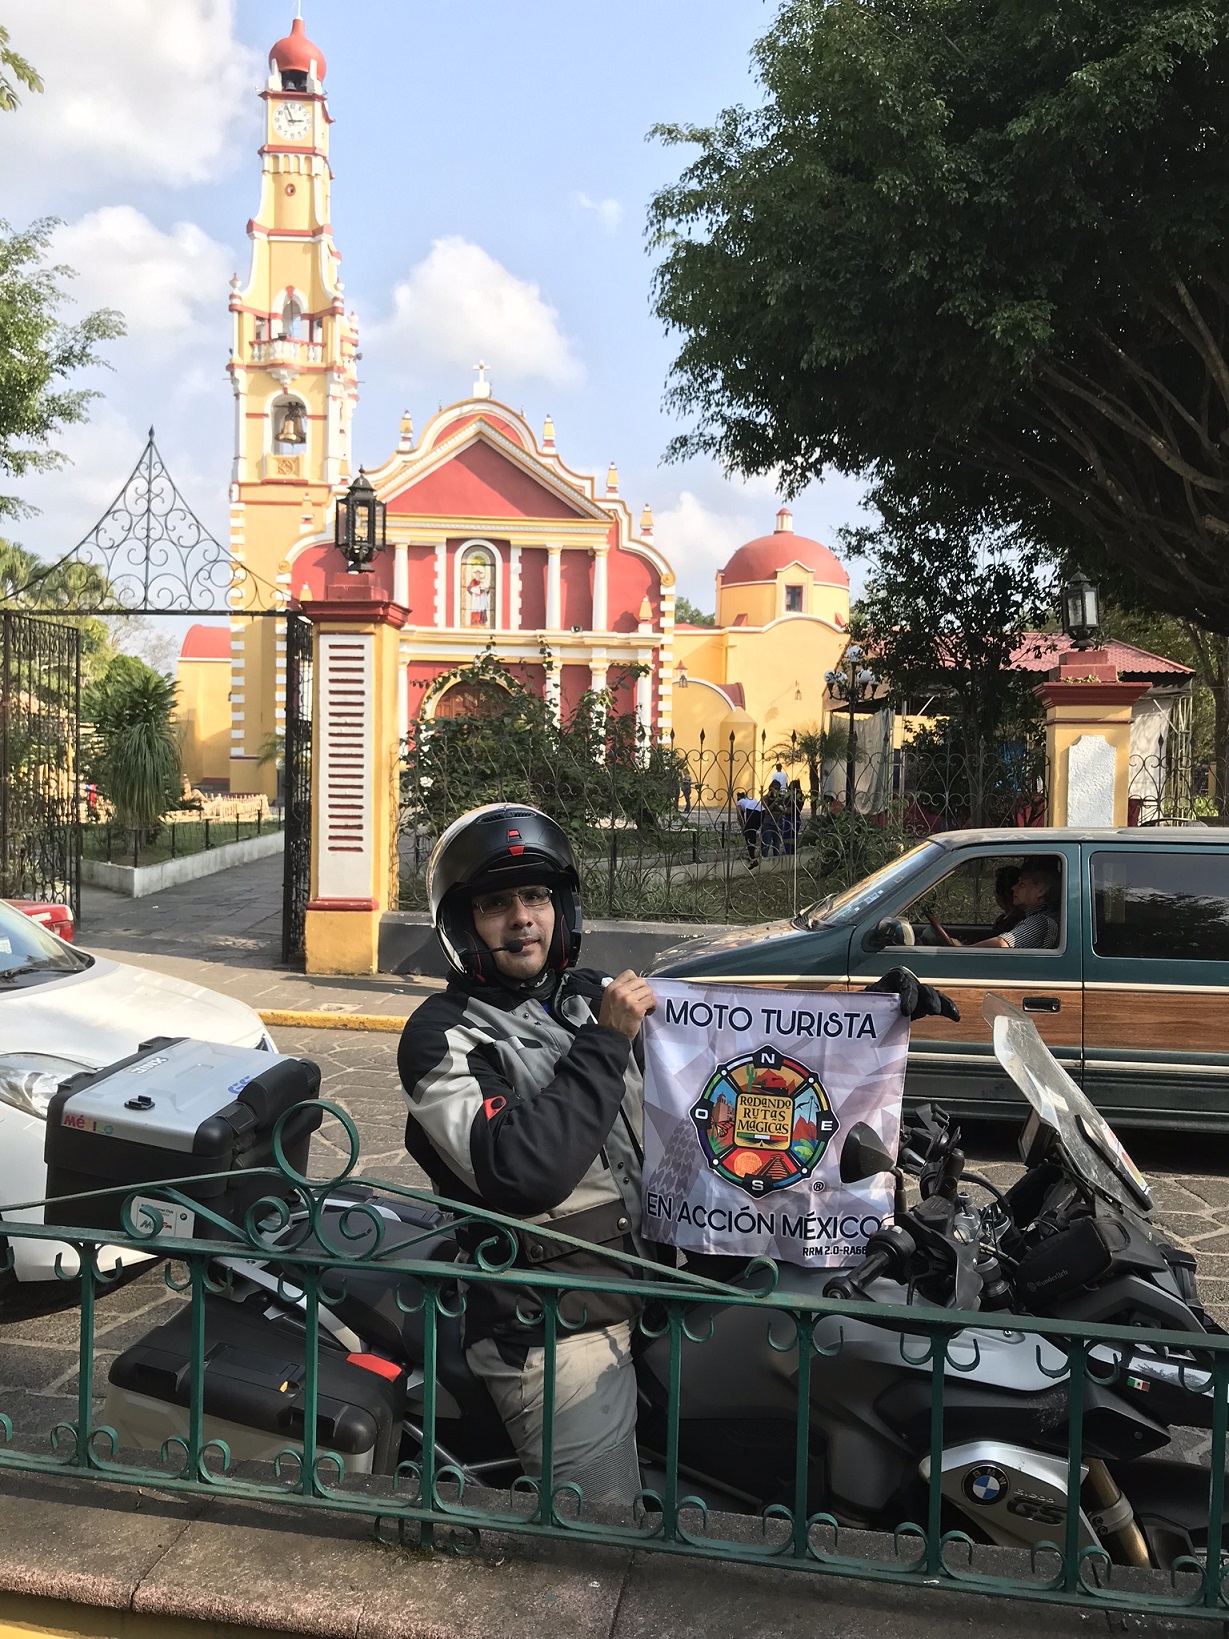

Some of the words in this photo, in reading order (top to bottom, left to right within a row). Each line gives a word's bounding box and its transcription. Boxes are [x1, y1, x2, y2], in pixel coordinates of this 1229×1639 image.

[666, 998, 753, 1032] MOTO
[761, 1008, 877, 1039] TURISTA
[761, 1052, 775, 1064] N
[695, 1108, 709, 1120] O
[820, 1120, 833, 1131] E
[751, 1179, 764, 1191] S
[647, 1191, 673, 1221] EN
[677, 1200, 775, 1235] ACCIÓN
[782, 1210, 881, 1240] MÉXICO
[802, 1246, 823, 1257] RRM
[972, 1467, 1007, 1485] BMW
[1006, 1496, 1068, 1526] GS
